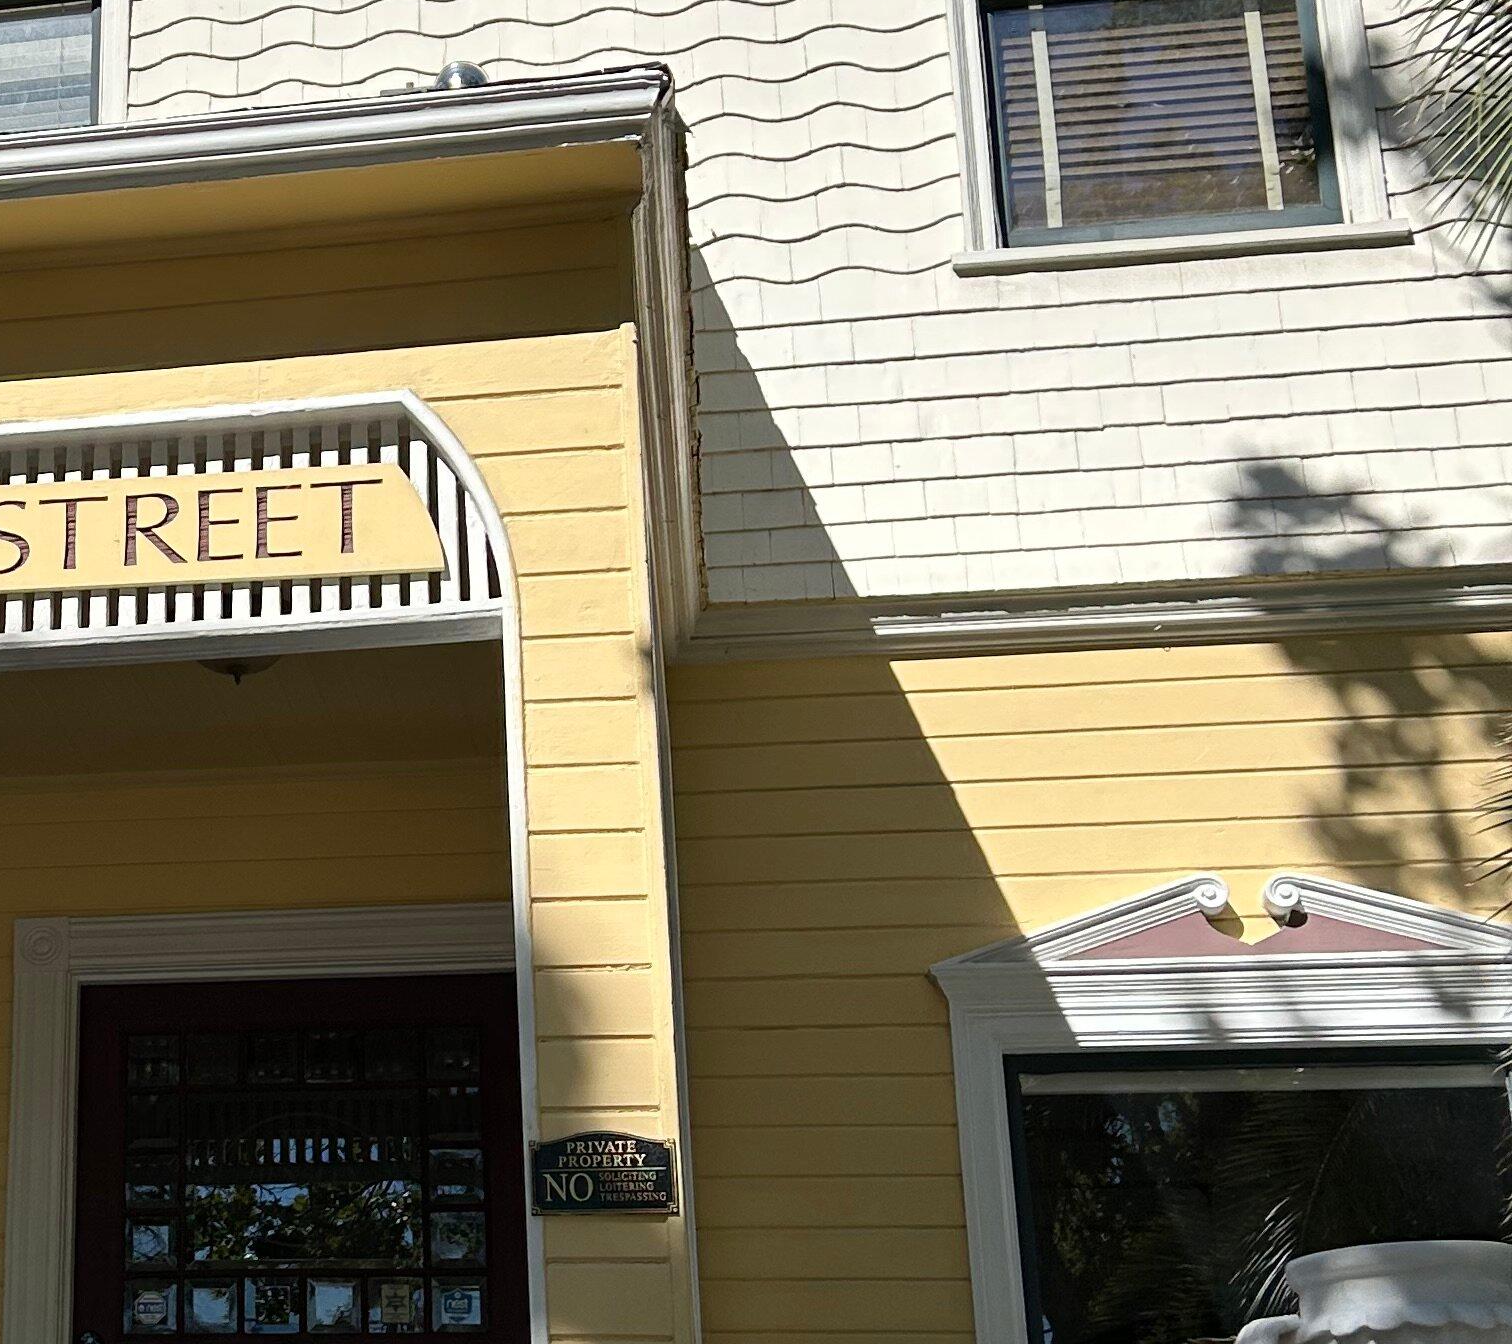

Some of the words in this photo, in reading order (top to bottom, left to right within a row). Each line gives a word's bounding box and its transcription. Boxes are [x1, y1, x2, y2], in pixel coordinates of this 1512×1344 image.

[566, 1140, 637, 1154] PRIVATE
[558, 1153, 647, 1168] PROPERTY
[599, 1171, 657, 1181] SOLICITING
[543, 1172, 594, 1202] NO
[600, 1181, 655, 1191] LOITERING
[600, 1191, 667, 1202] TRESPASSING
